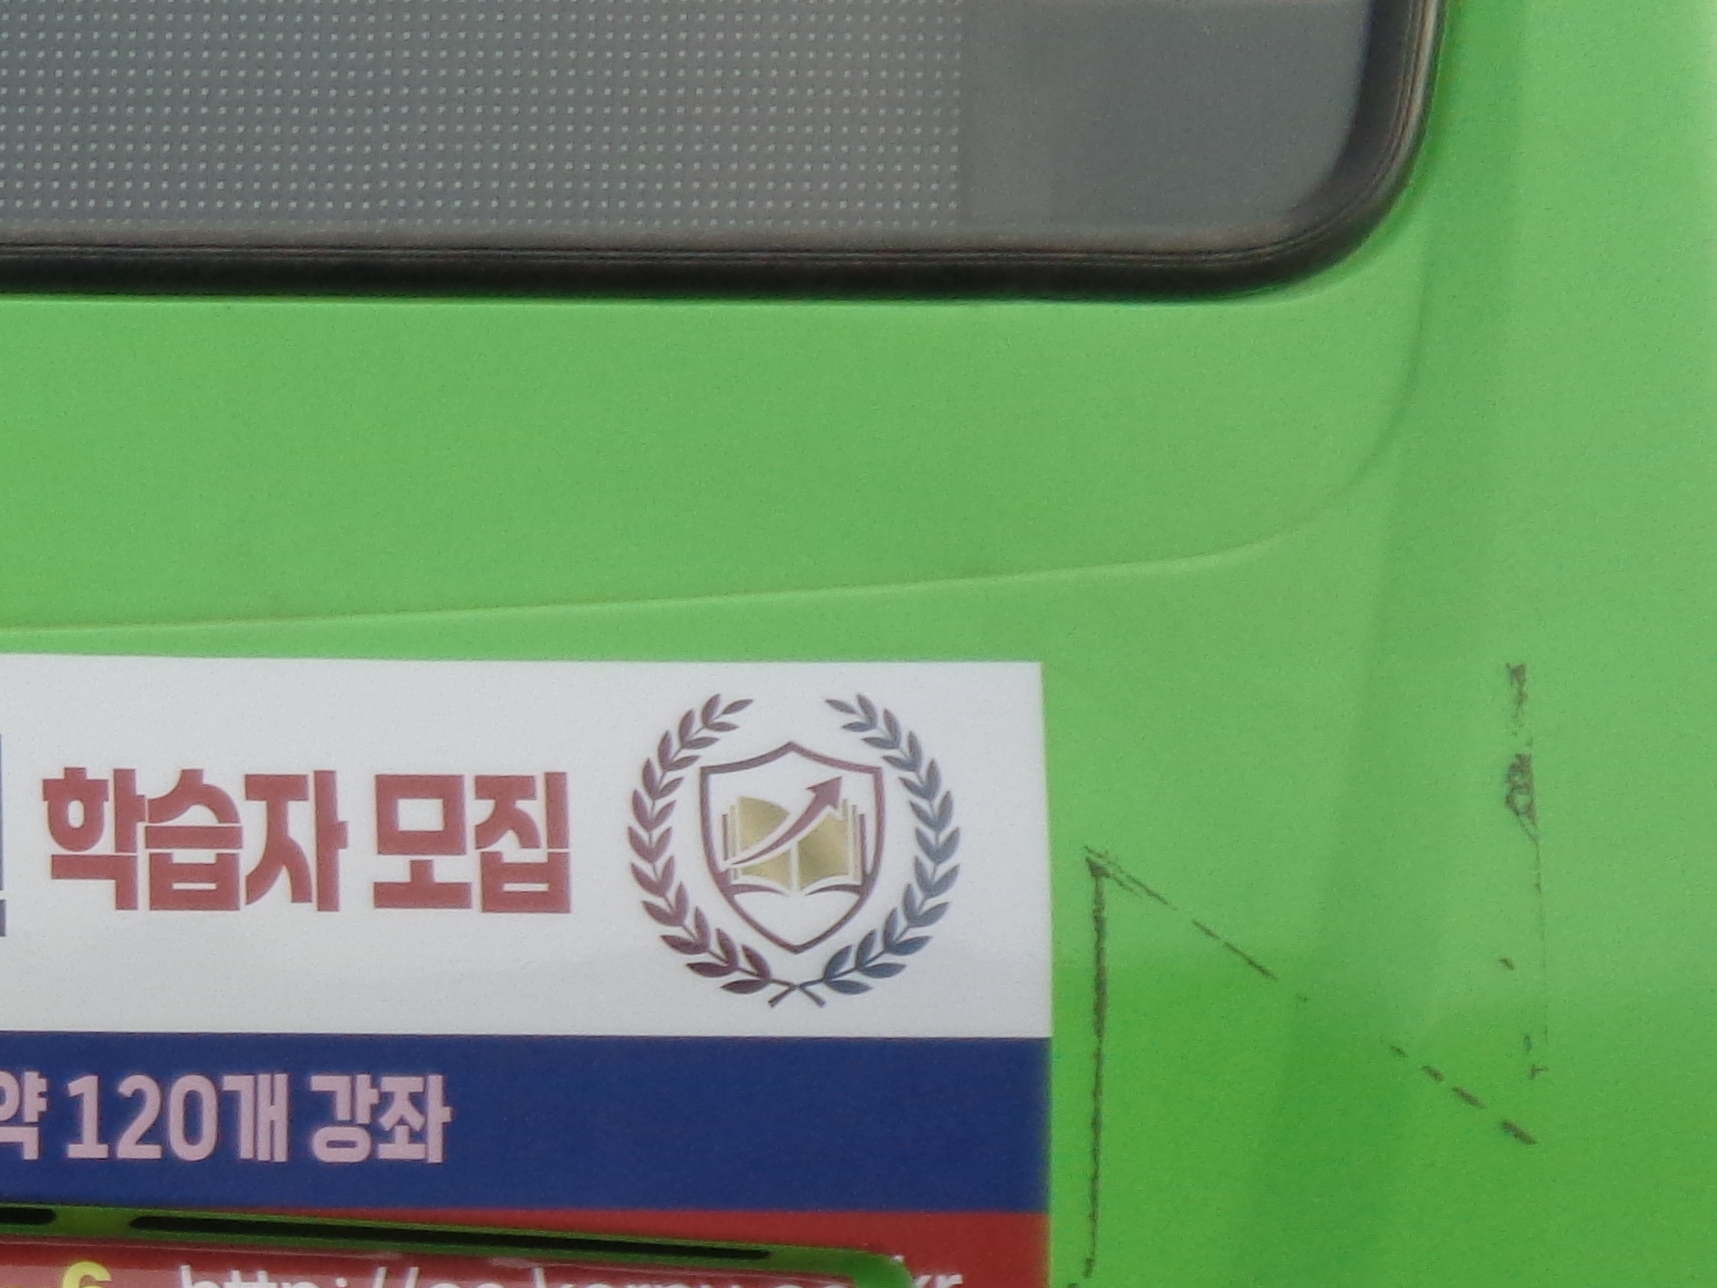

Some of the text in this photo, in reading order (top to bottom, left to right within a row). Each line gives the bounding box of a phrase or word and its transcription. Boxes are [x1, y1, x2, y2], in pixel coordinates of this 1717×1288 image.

[41, 766, 348, 912] 학습자
[371, 771, 572, 913] 모집
[66, 1072, 289, 1164] 120개
[308, 1073, 451, 1165] 강좌
